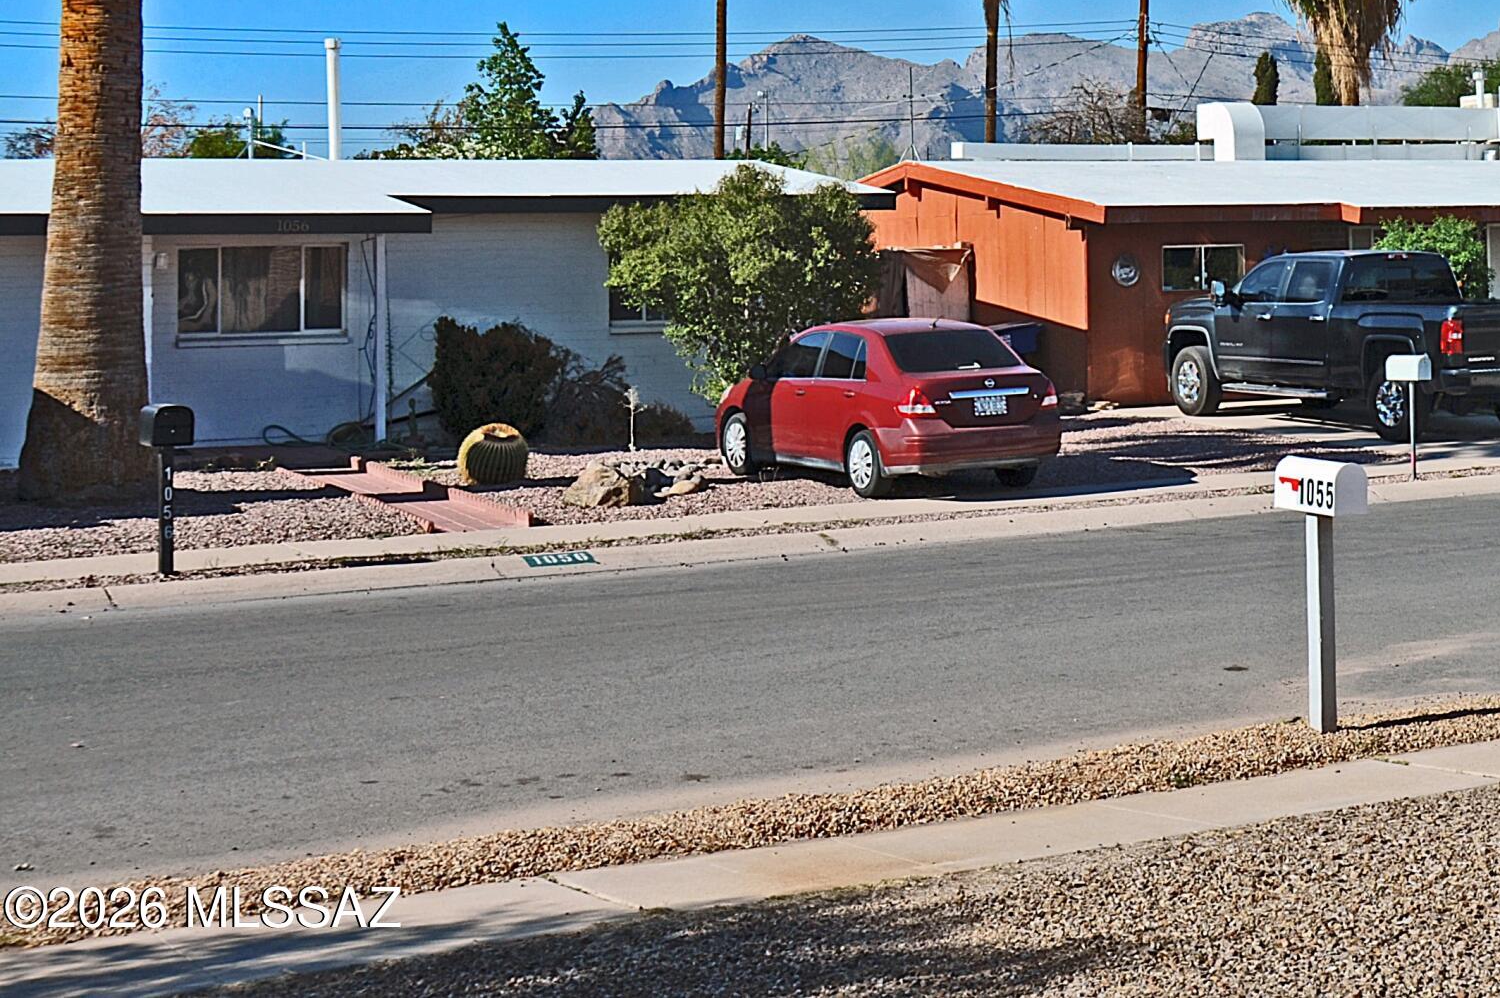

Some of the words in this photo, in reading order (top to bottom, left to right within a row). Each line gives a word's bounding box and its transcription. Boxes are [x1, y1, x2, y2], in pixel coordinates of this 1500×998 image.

[277, 219, 310, 232] 1056
[163, 466, 173, 539] 1056
[1299, 477, 1334, 510] 1055
